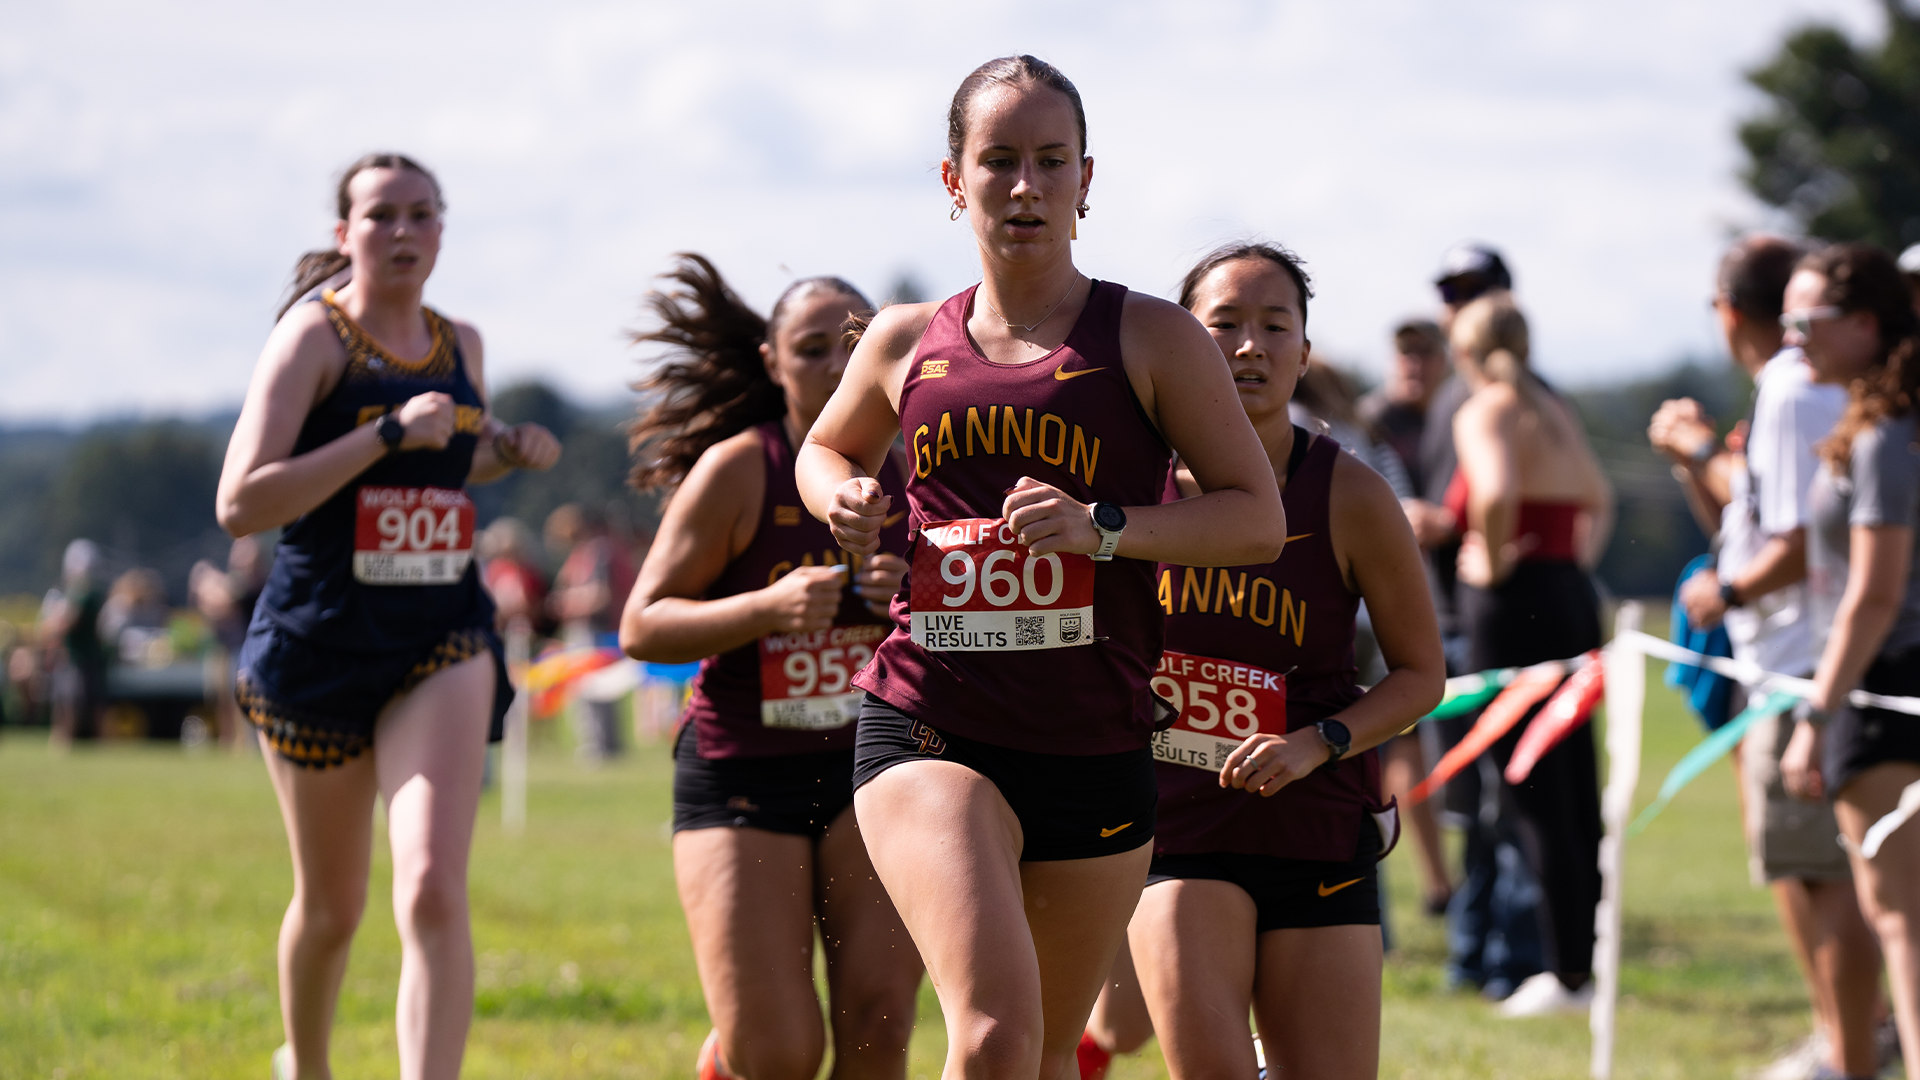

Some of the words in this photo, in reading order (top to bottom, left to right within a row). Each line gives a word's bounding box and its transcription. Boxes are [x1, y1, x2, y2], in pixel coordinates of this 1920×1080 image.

[921, 364, 949, 375] PSAC
[913, 404, 1101, 488] GANNON
[377, 506, 461, 551] 904
[926, 523, 992, 546] WOLF
[940, 549, 1064, 607] 960
[924, 615, 965, 631] LIVE
[1158, 566, 1307, 648] ANNON
[925, 632, 1008, 648] RESULTS
[1156, 656, 1195, 676] OLF
[1200, 662, 1280, 692] CREEK
[1149, 675, 1260, 738] 958
[1151, 731, 1171, 745] VE
